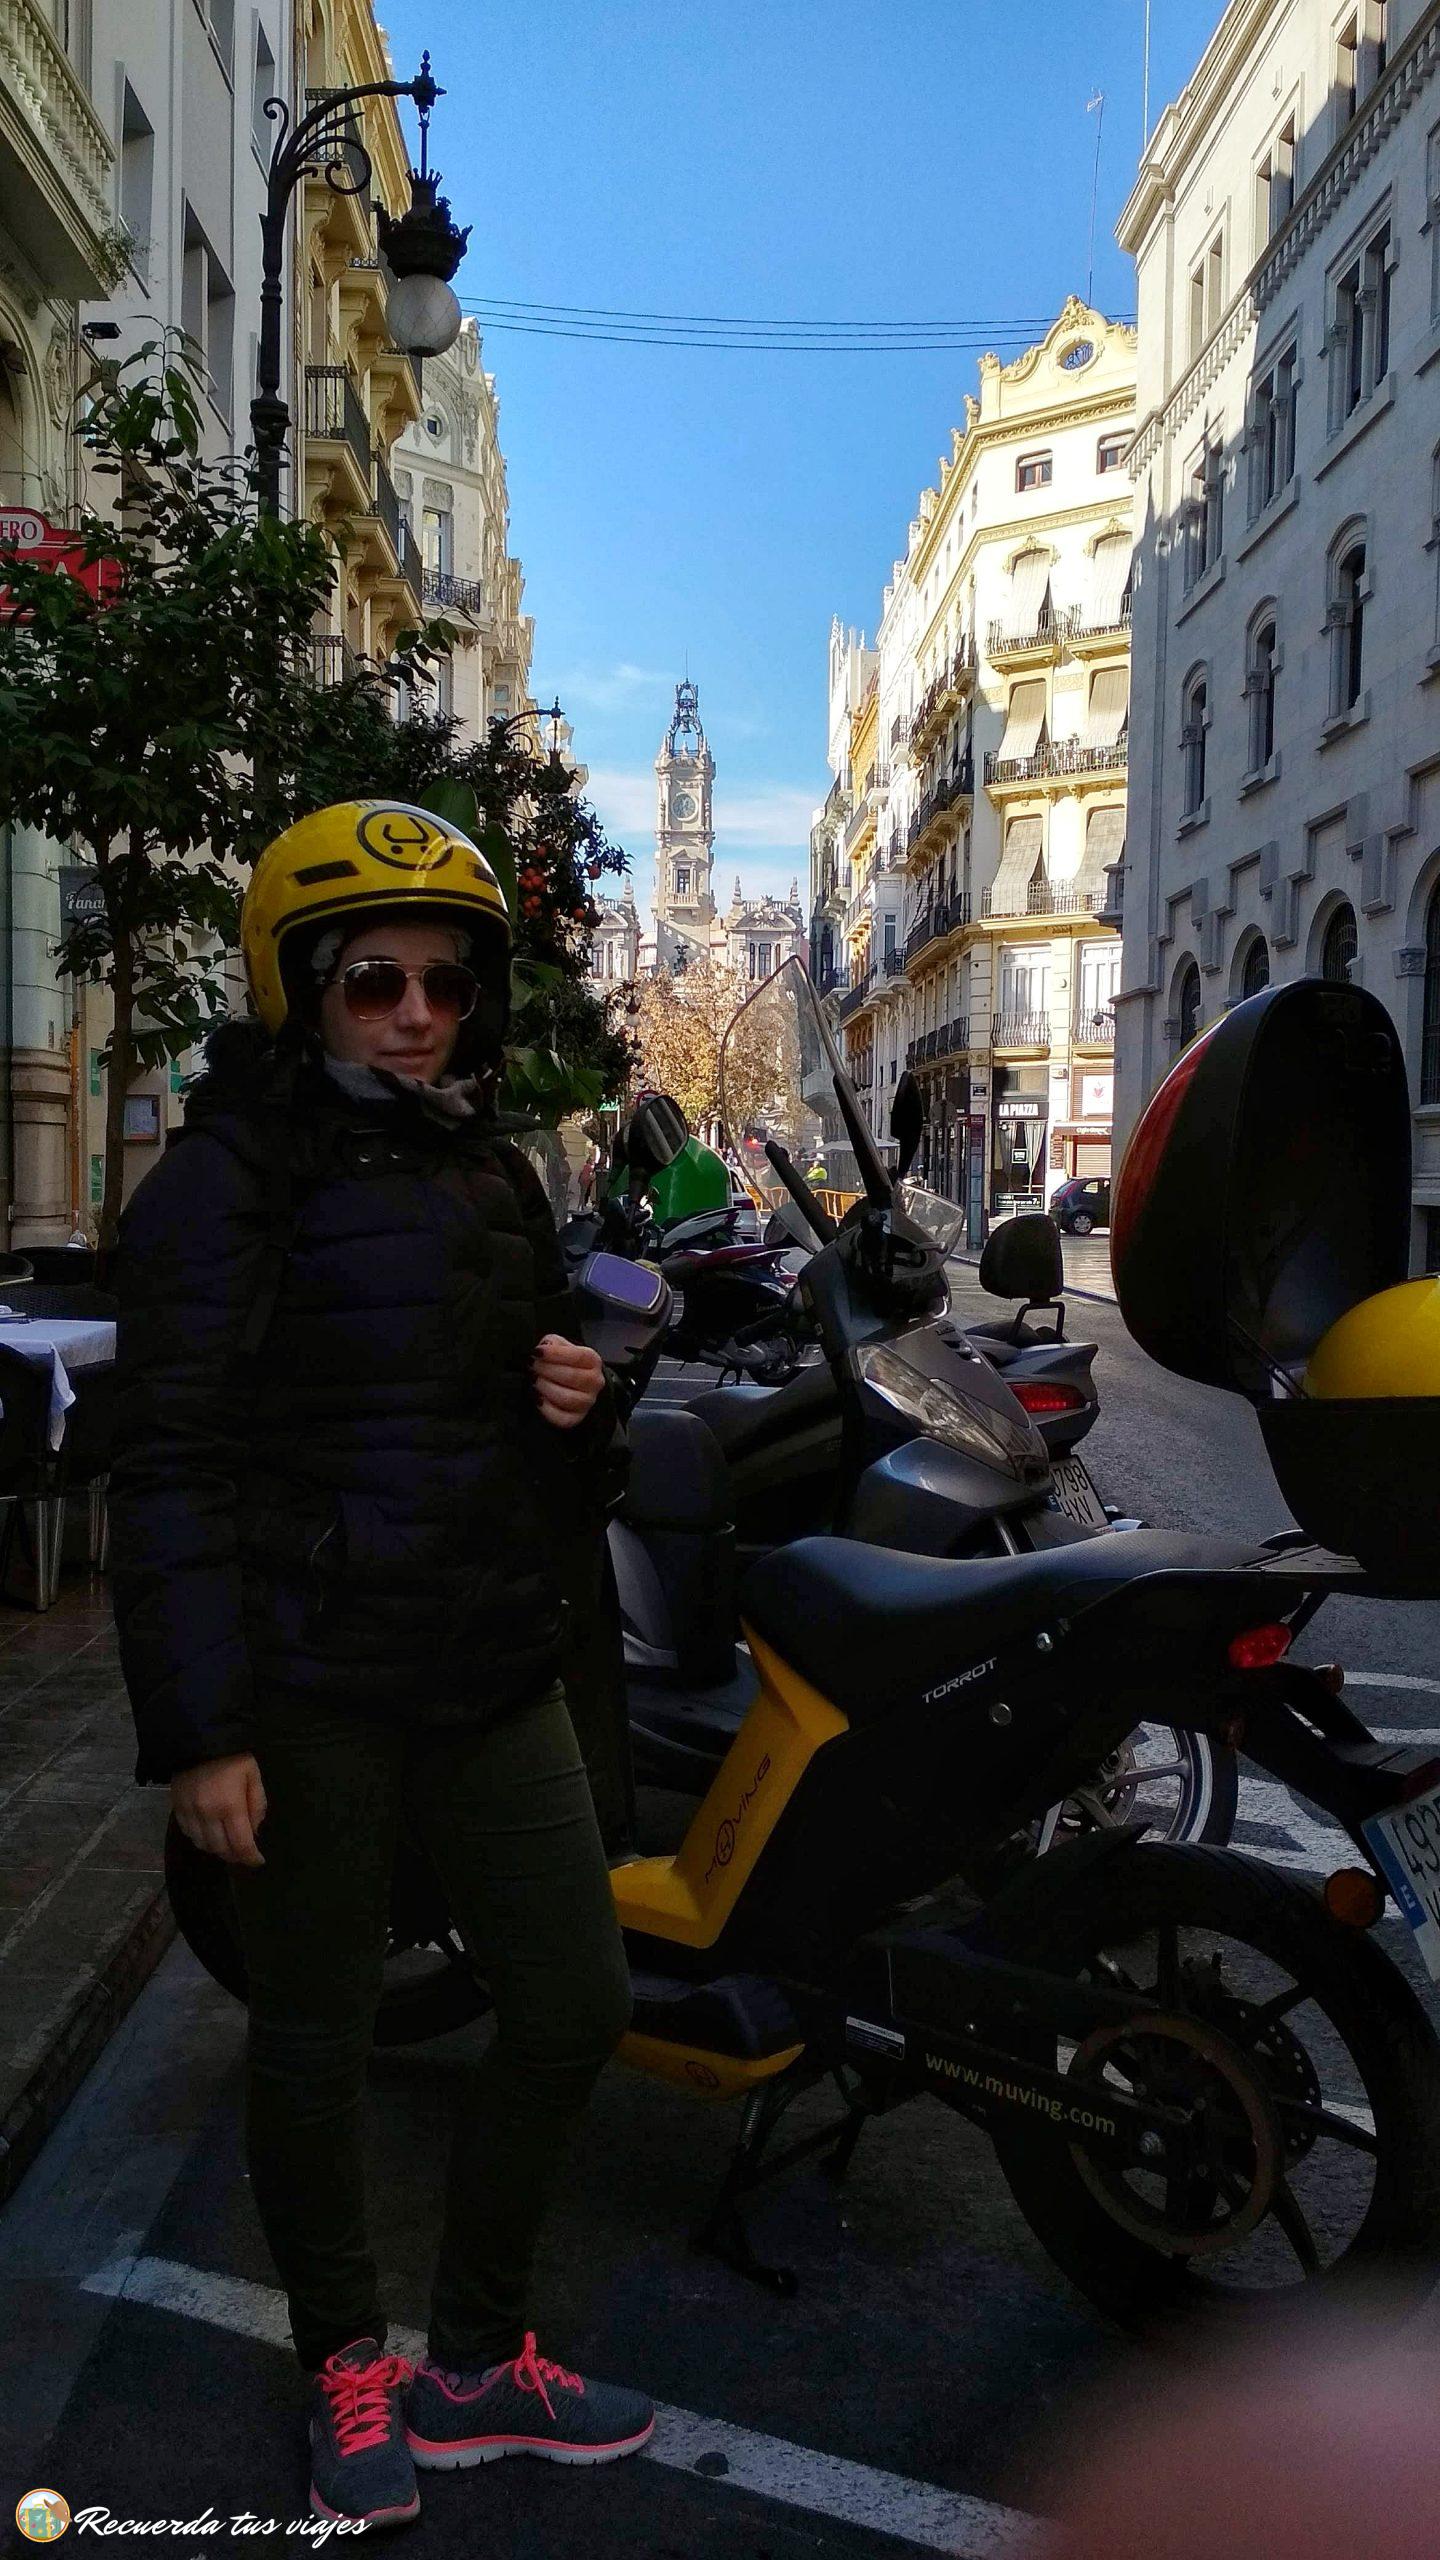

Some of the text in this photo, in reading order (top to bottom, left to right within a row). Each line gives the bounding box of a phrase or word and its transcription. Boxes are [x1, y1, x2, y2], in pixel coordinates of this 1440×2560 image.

[999, 1103, 1039, 1117] LA PIAZZA
[922, 1657, 998, 1704] TORROT
[924, 2051, 1117, 2137] www.muving.com
